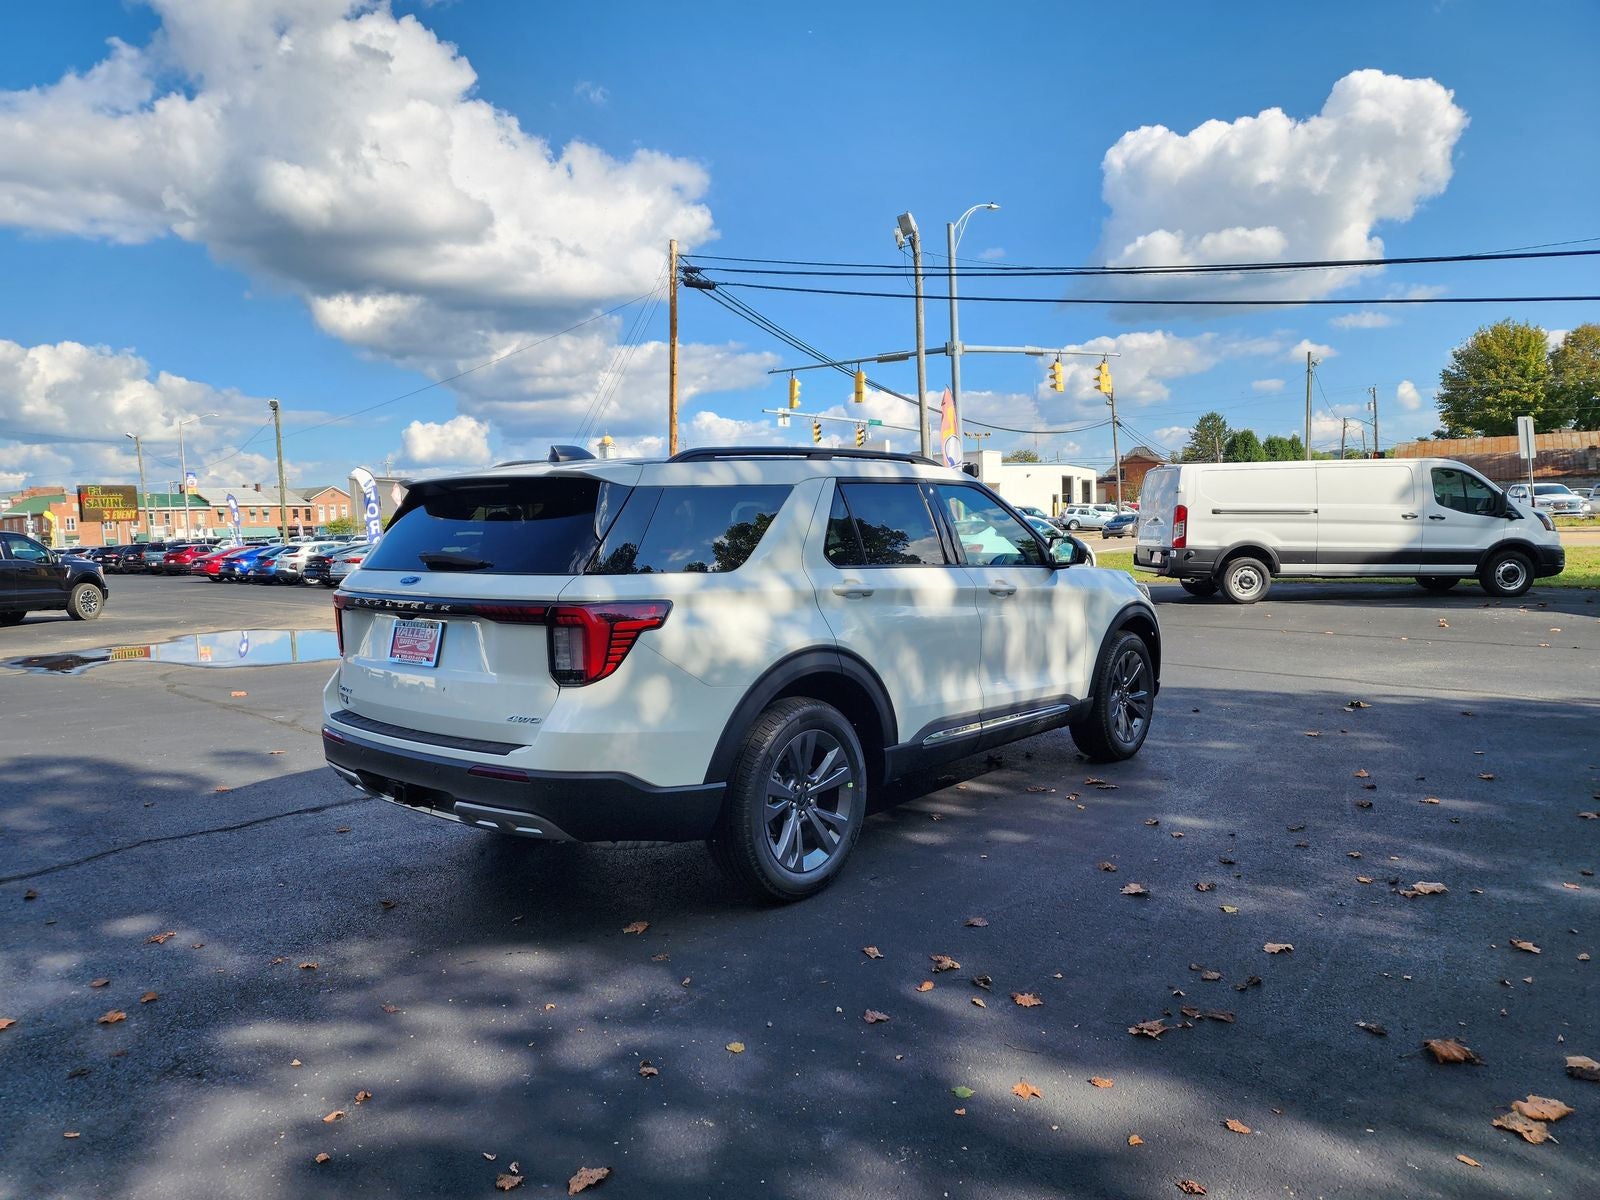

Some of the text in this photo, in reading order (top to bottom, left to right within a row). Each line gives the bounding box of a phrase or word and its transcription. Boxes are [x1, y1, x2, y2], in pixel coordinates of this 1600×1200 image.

[354, 598, 451, 612] EXPLORER
[396, 627, 438, 641] VALLERY
[506, 715, 542, 724] 4WD
